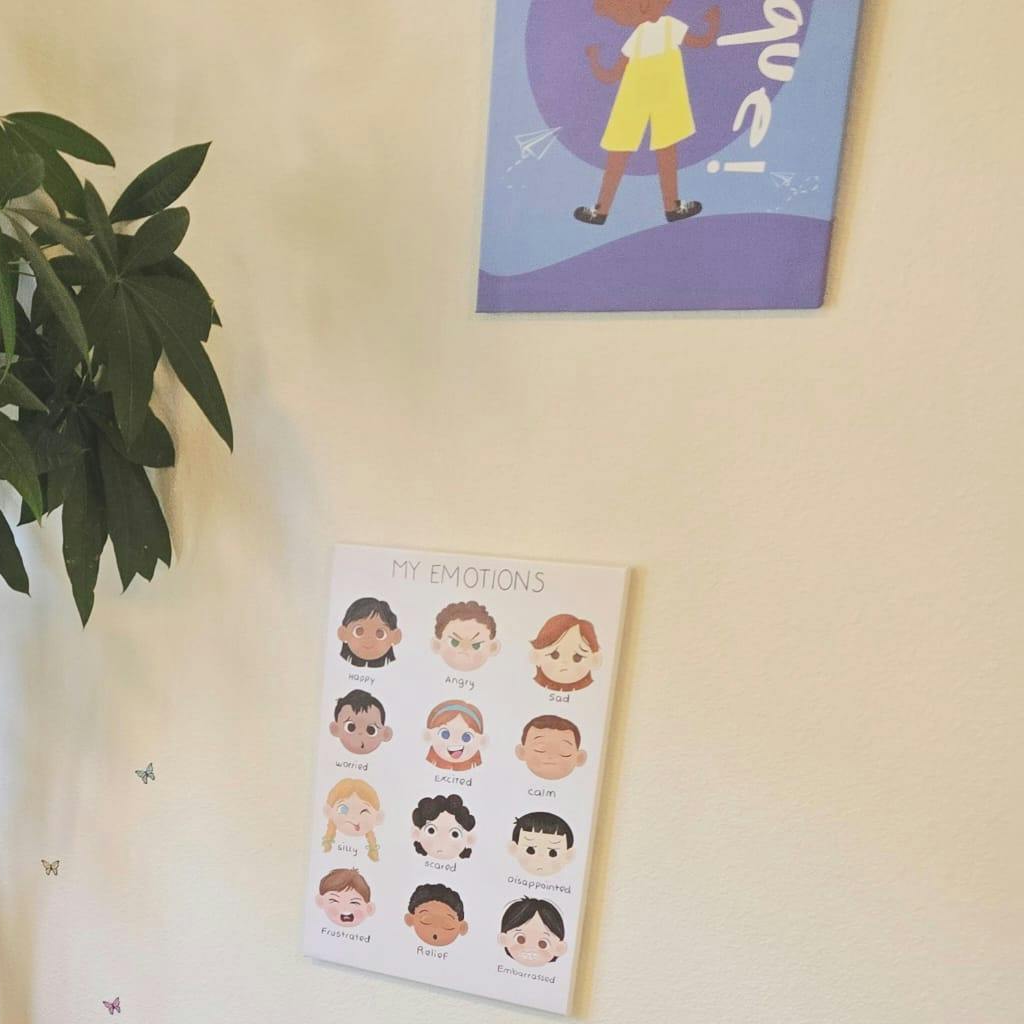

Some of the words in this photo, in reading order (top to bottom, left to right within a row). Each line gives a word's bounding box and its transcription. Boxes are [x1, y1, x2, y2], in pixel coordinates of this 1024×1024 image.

[391, 559, 422, 582] MY
[430, 564, 545, 594] EMOTIONS
[348, 672, 376, 686] Happy
[445, 675, 476, 690] Angry
[507, 875, 572, 894] Disappointed
[321, 927, 371, 943] Frustrated
[416, 945, 449, 960] Relief
[497, 964, 556, 985] Embarrassed
